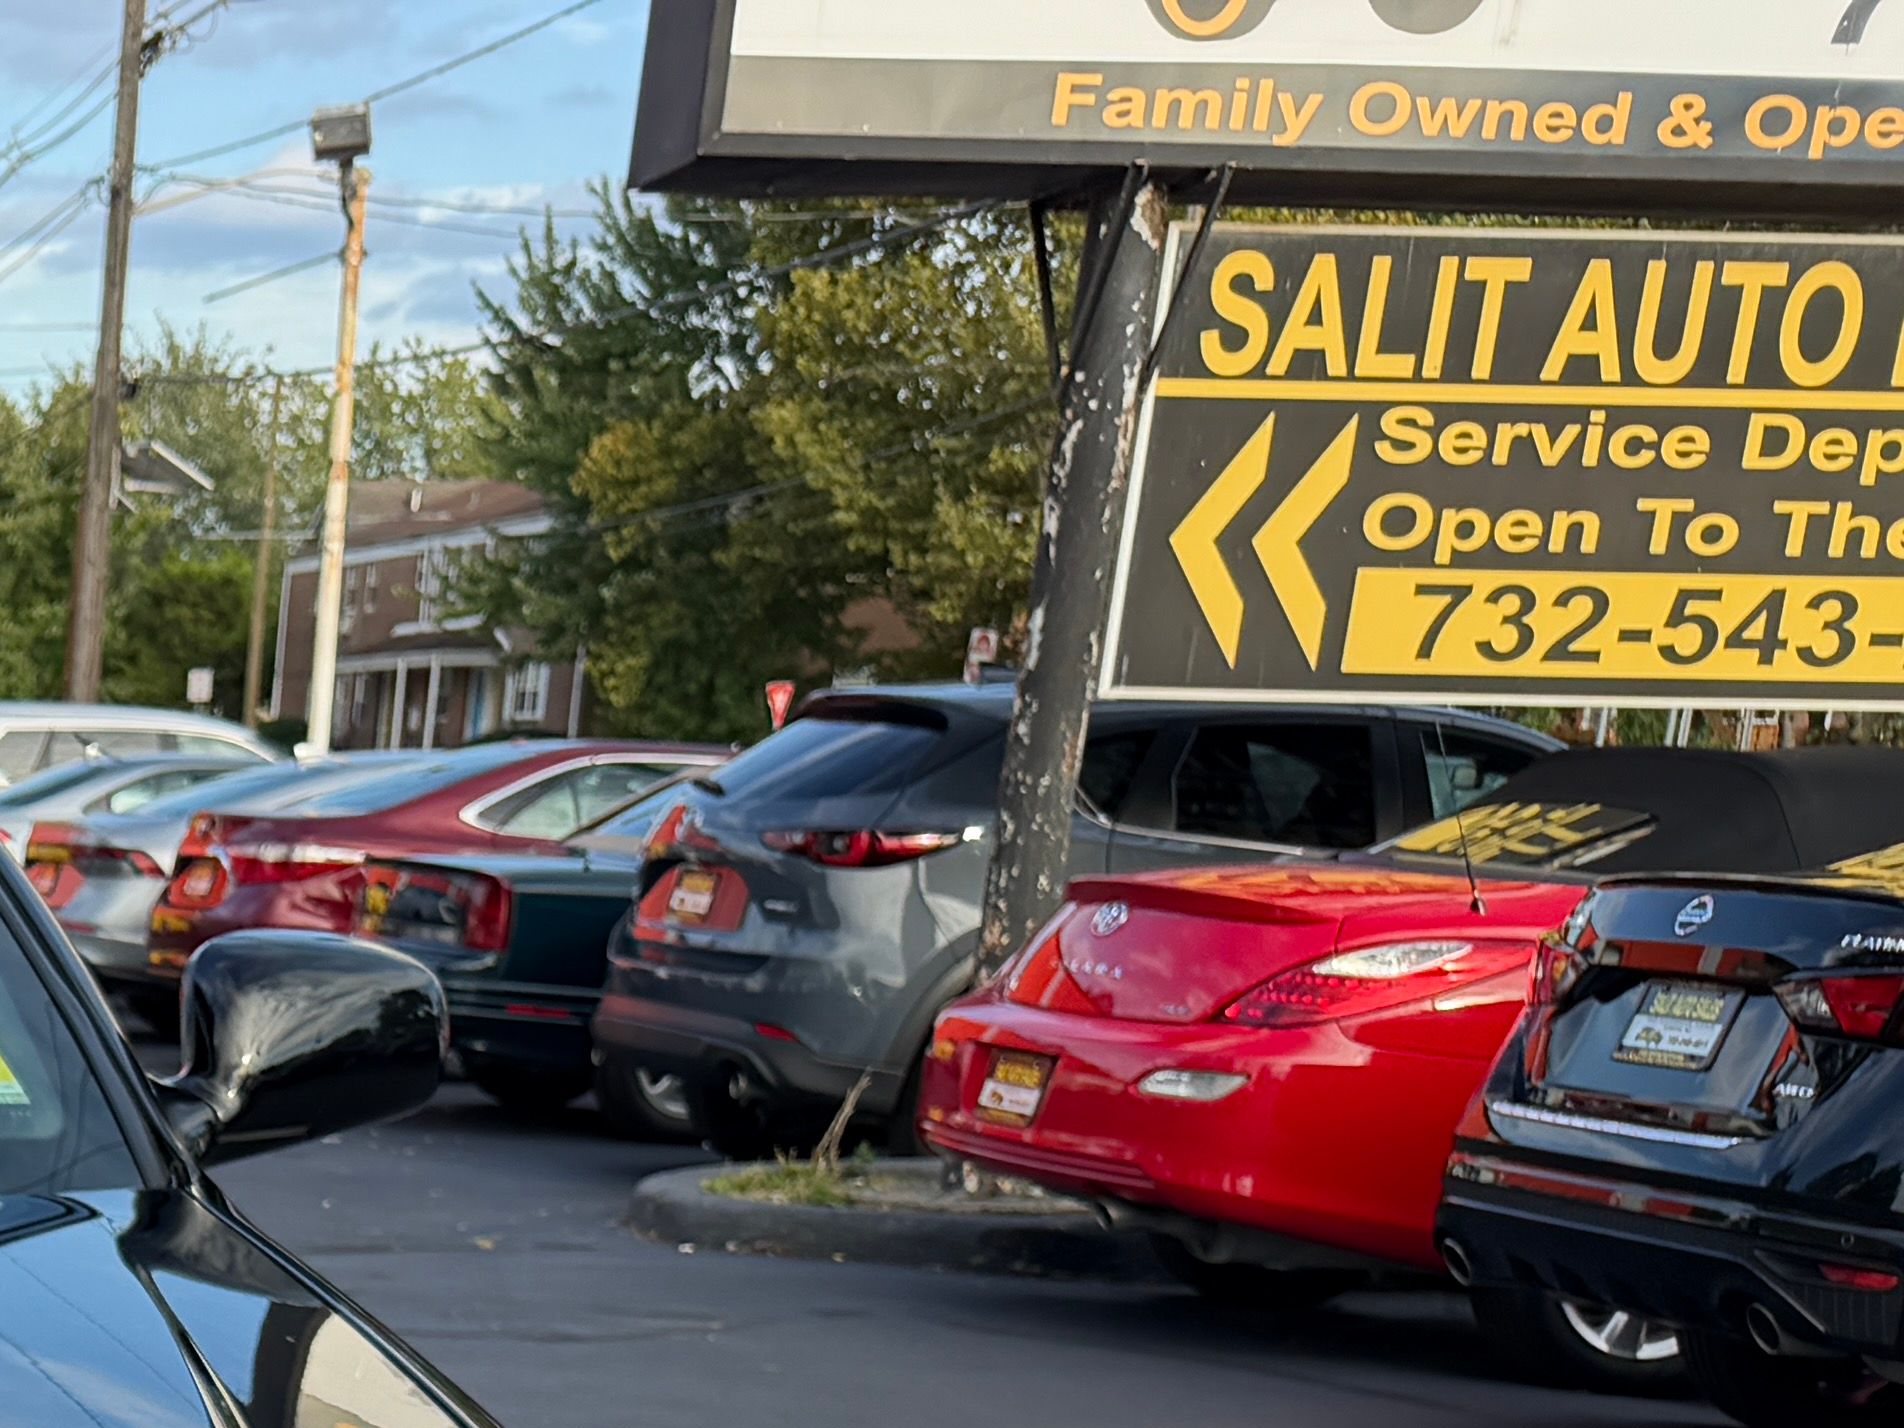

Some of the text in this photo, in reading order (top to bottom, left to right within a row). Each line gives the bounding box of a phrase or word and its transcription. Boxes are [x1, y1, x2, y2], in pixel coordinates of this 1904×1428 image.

[1051, 71, 1904, 159] Family Owned & Ope
[1199, 249, 1533, 380] SALIT
[1540, 258, 1864, 387] AUTO
[1374, 405, 1904, 486] Service Dep
[1362, 492, 1601, 565] Open
[1637, 498, 1740, 557] To
